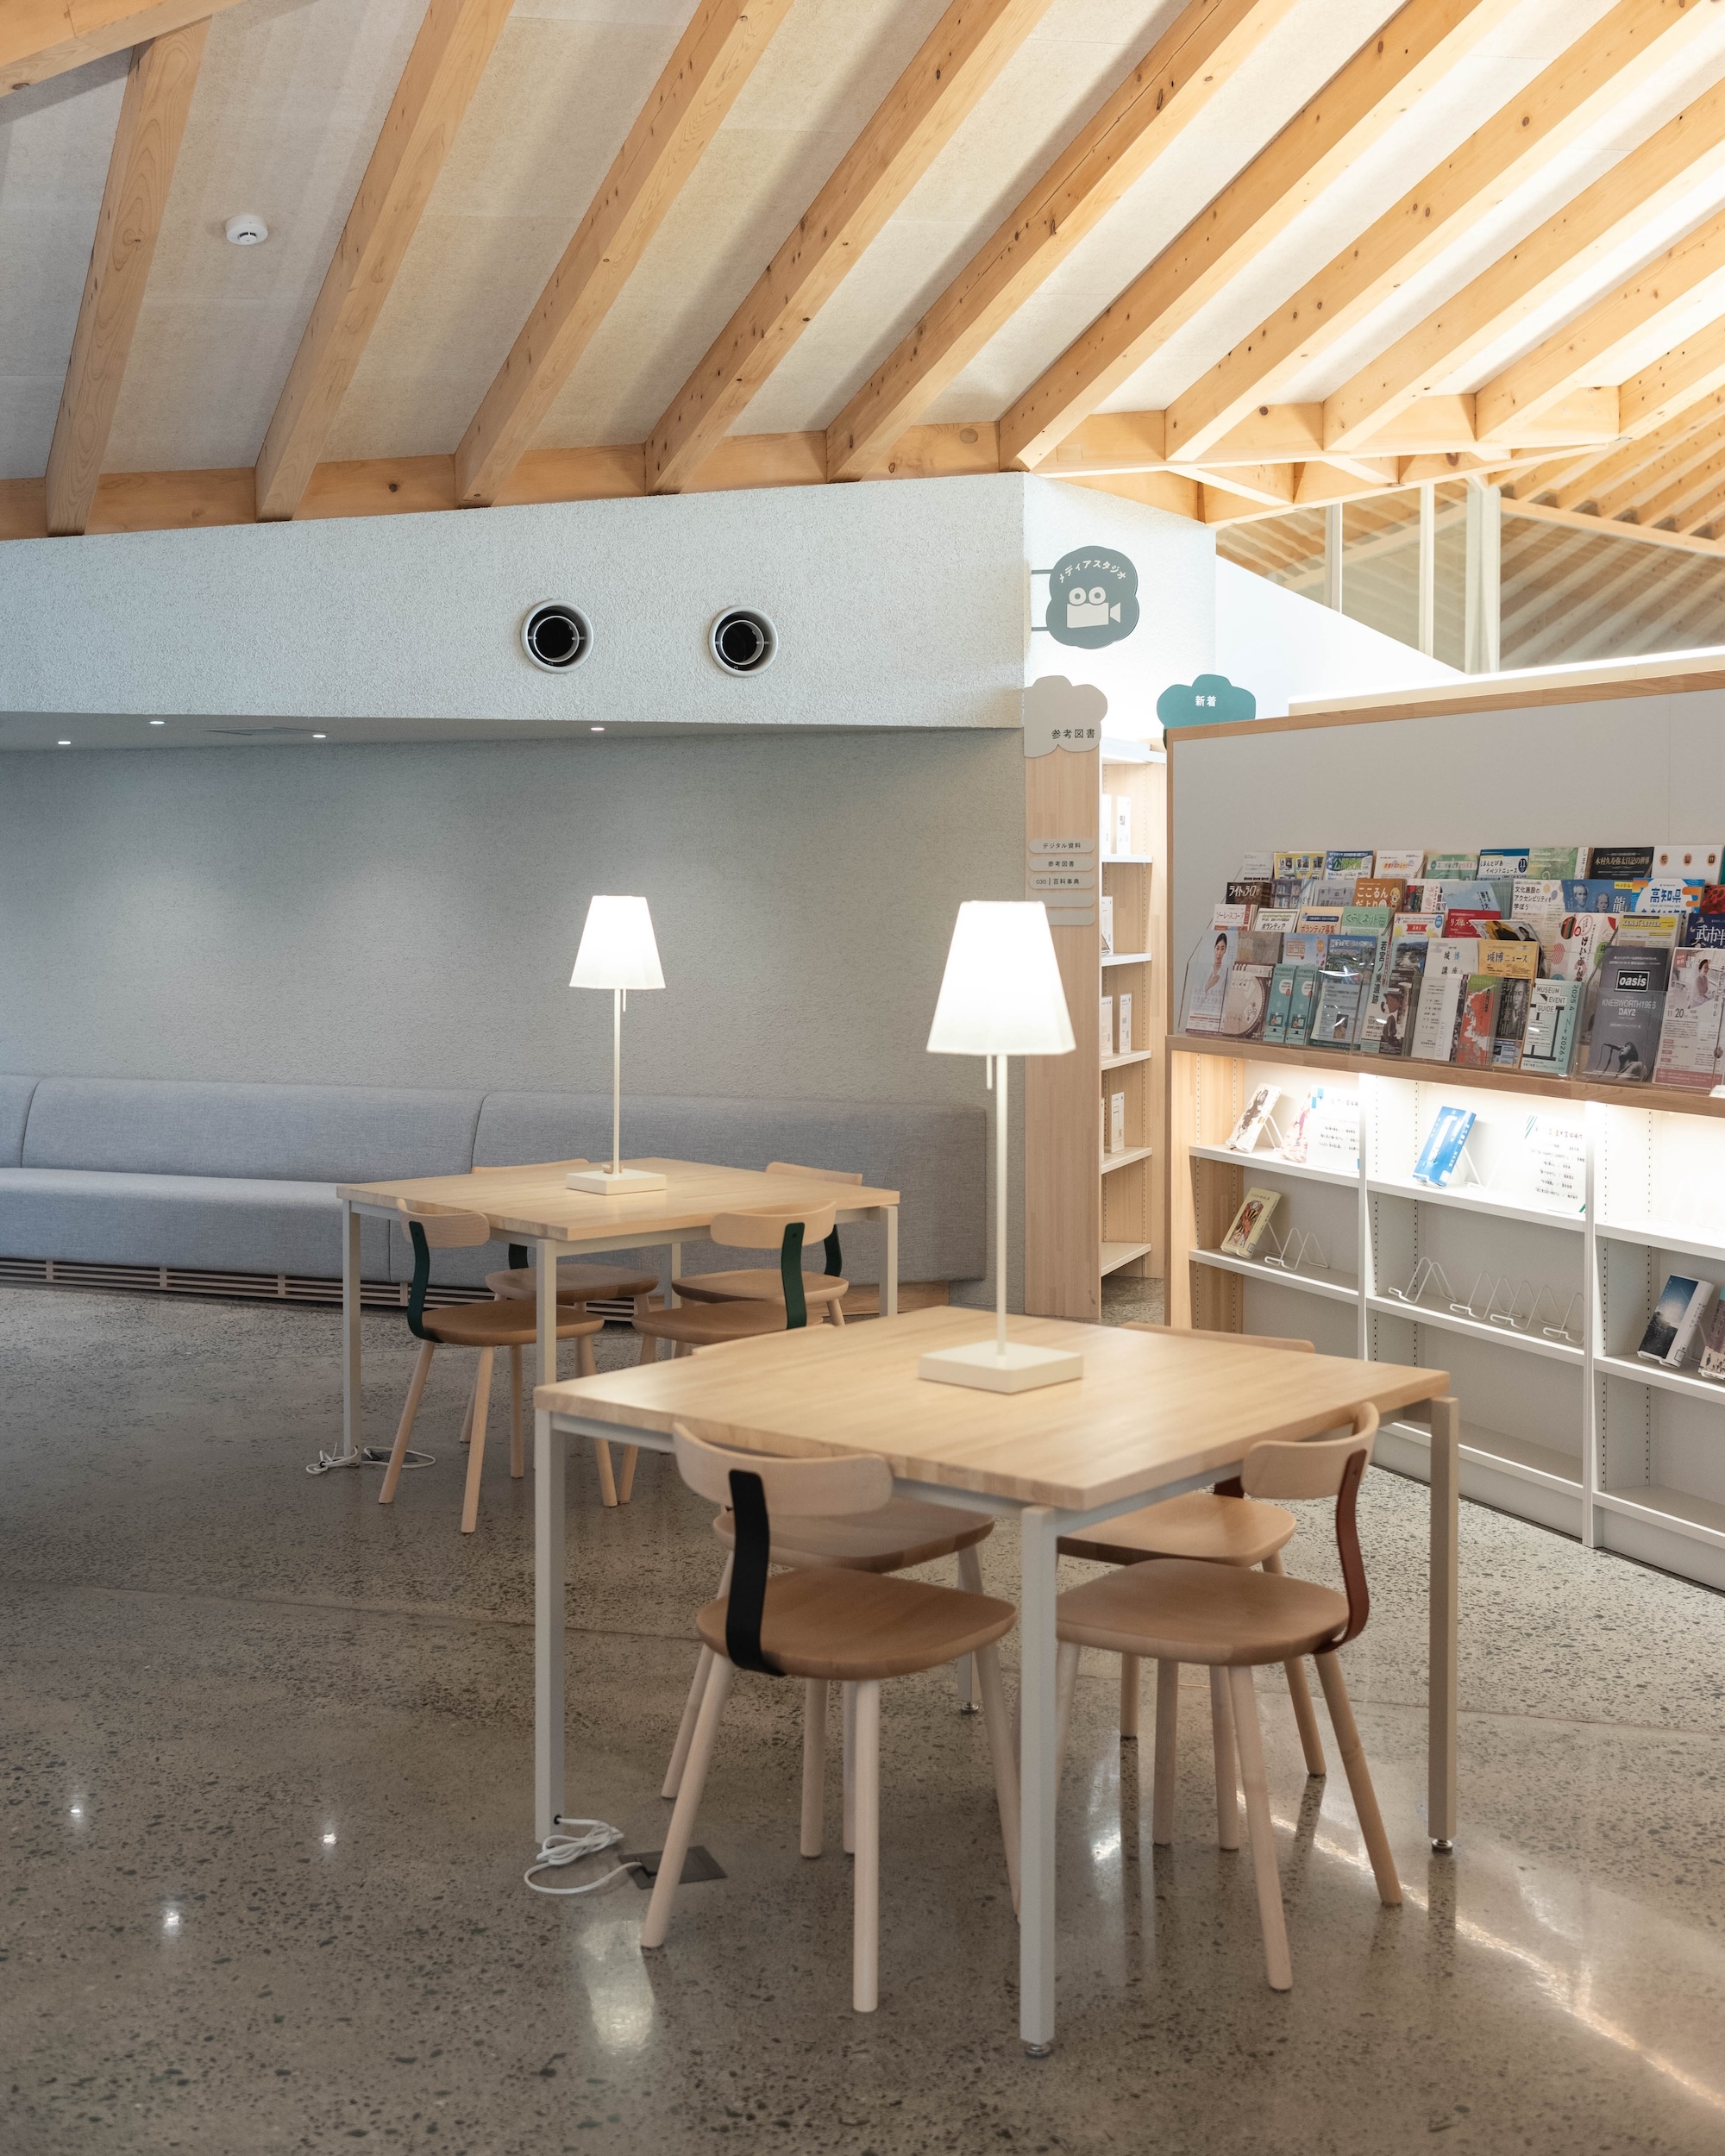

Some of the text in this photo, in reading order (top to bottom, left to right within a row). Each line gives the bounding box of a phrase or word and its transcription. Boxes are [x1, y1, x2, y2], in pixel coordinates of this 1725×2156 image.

[1059, 560, 1126, 583] メディアスタジオ
[1195, 695, 1217, 707] 新着
[1051, 729, 1095, 739] 参考図書
[1357, 887, 1388, 898] こころん
[1649, 888, 1682, 904] 高知県
[1619, 975, 1647, 987] oasis
[1536, 986, 1560, 994] MUSEUM
[1602, 999, 1657, 1010] KNEBWORTH1996
[1618, 1007, 1636, 1017] DAY2
[1674, 1008, 1684, 1018] 20
